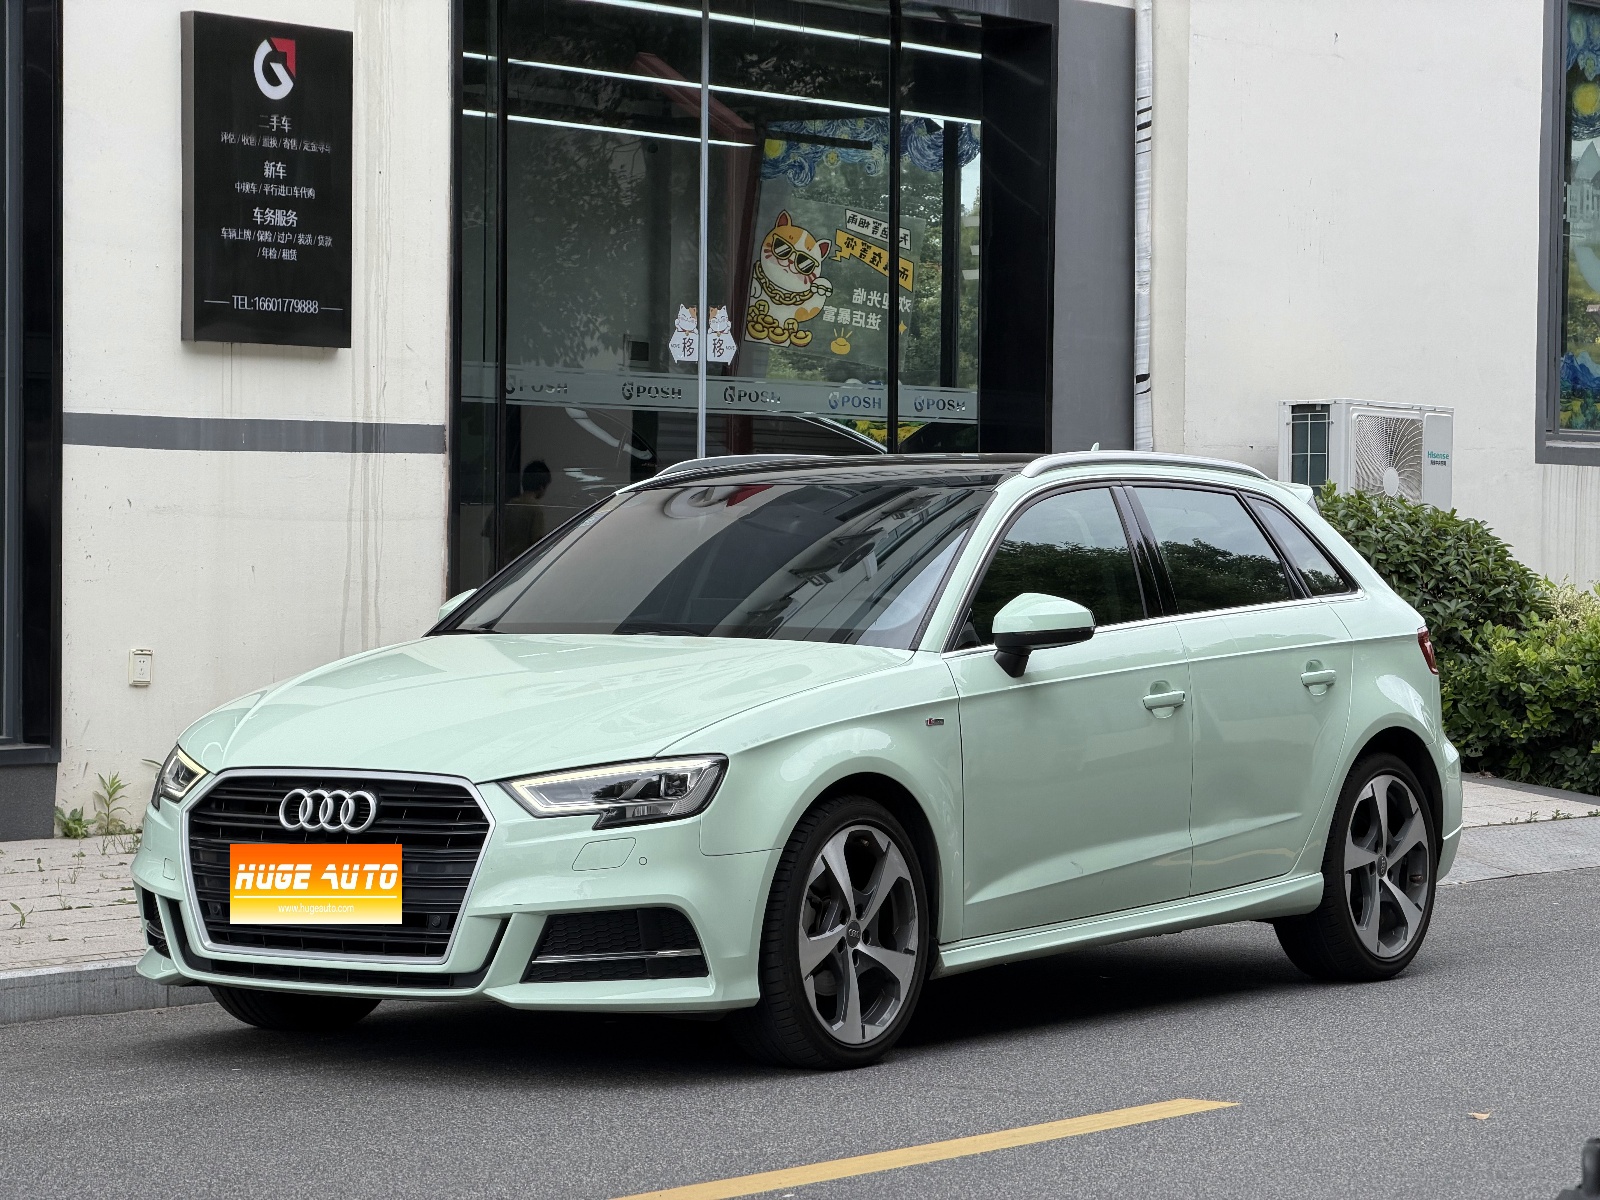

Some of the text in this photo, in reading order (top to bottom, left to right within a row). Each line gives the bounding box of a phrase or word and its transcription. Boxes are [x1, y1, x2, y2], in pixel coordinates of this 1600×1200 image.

[259, 114, 292, 133] 二手车
[263, 160, 287, 180] 新车
[252, 206, 298, 228] 车务服务
[231, 295, 319, 314] TEL:16601779888
[682, 337, 695, 358] 移
[712, 338, 725, 358] 移
[636, 385, 682, 400] POSH
[738, 389, 781, 404] POSH
[841, 395, 882, 410] POSH
[926, 398, 966, 412] POSH
[1427, 450, 1450, 460] Hisense
